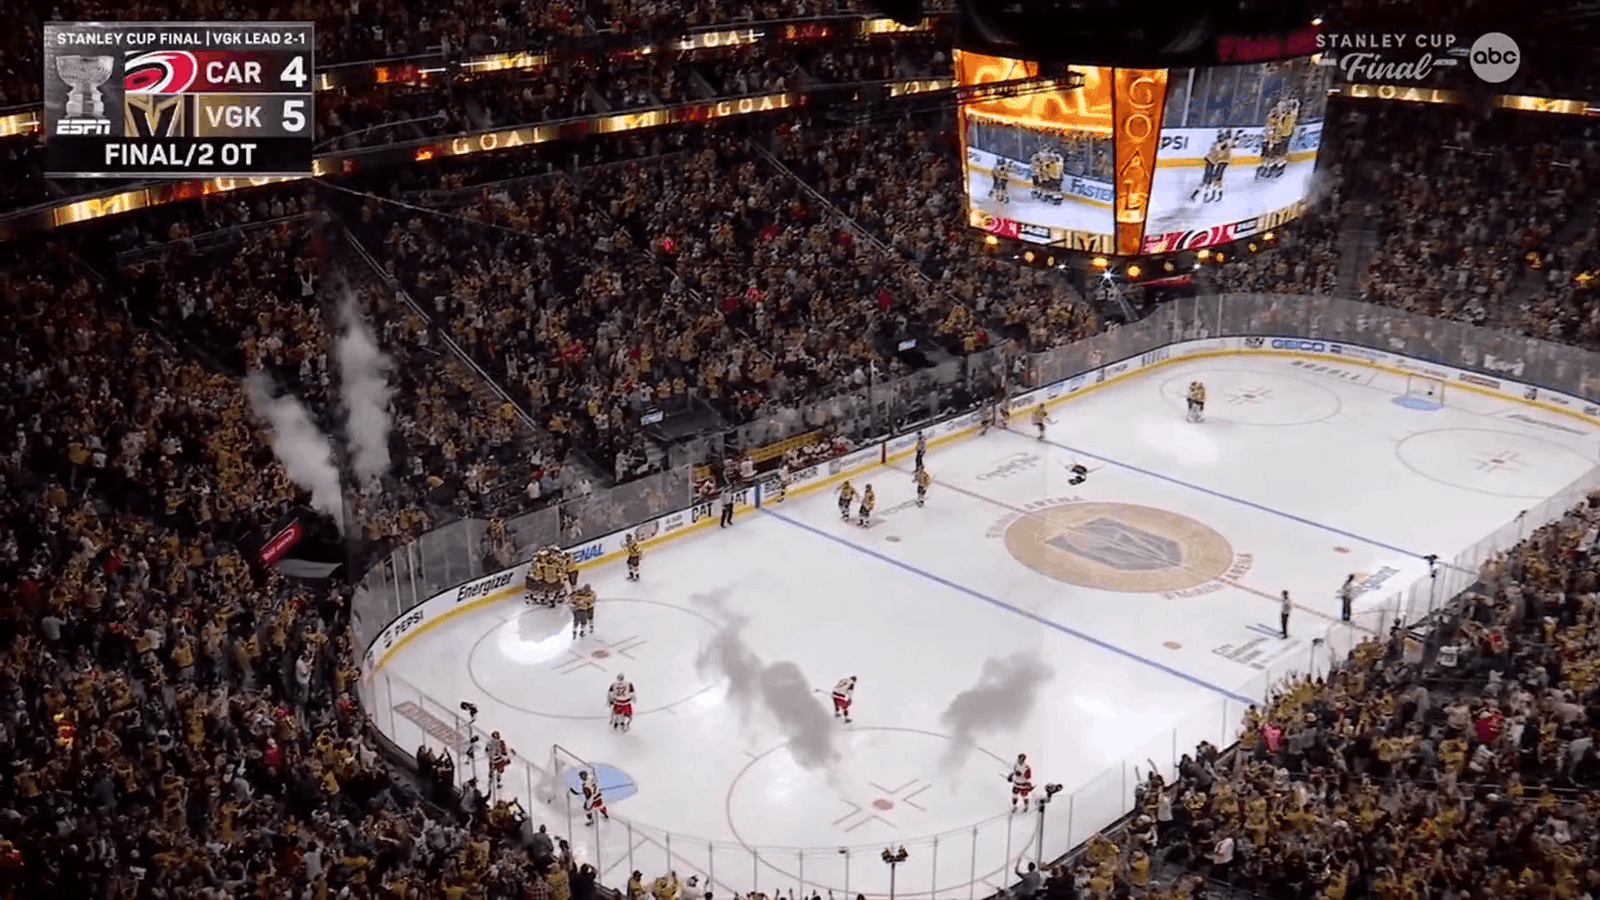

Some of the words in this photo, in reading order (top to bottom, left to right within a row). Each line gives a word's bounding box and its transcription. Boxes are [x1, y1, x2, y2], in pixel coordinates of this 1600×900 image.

[717, 94, 789, 117] GOAL
[1351, 84, 1441, 103] GOAL
[452, 126, 544, 155] GOAL
[1119, 77, 1156, 212] GOAL
[1161, 136, 1189, 150] PSI
[692, 503, 712, 523] CAT
[456, 572, 514, 602] Energizer
[395, 610, 425, 637] PEPSI
